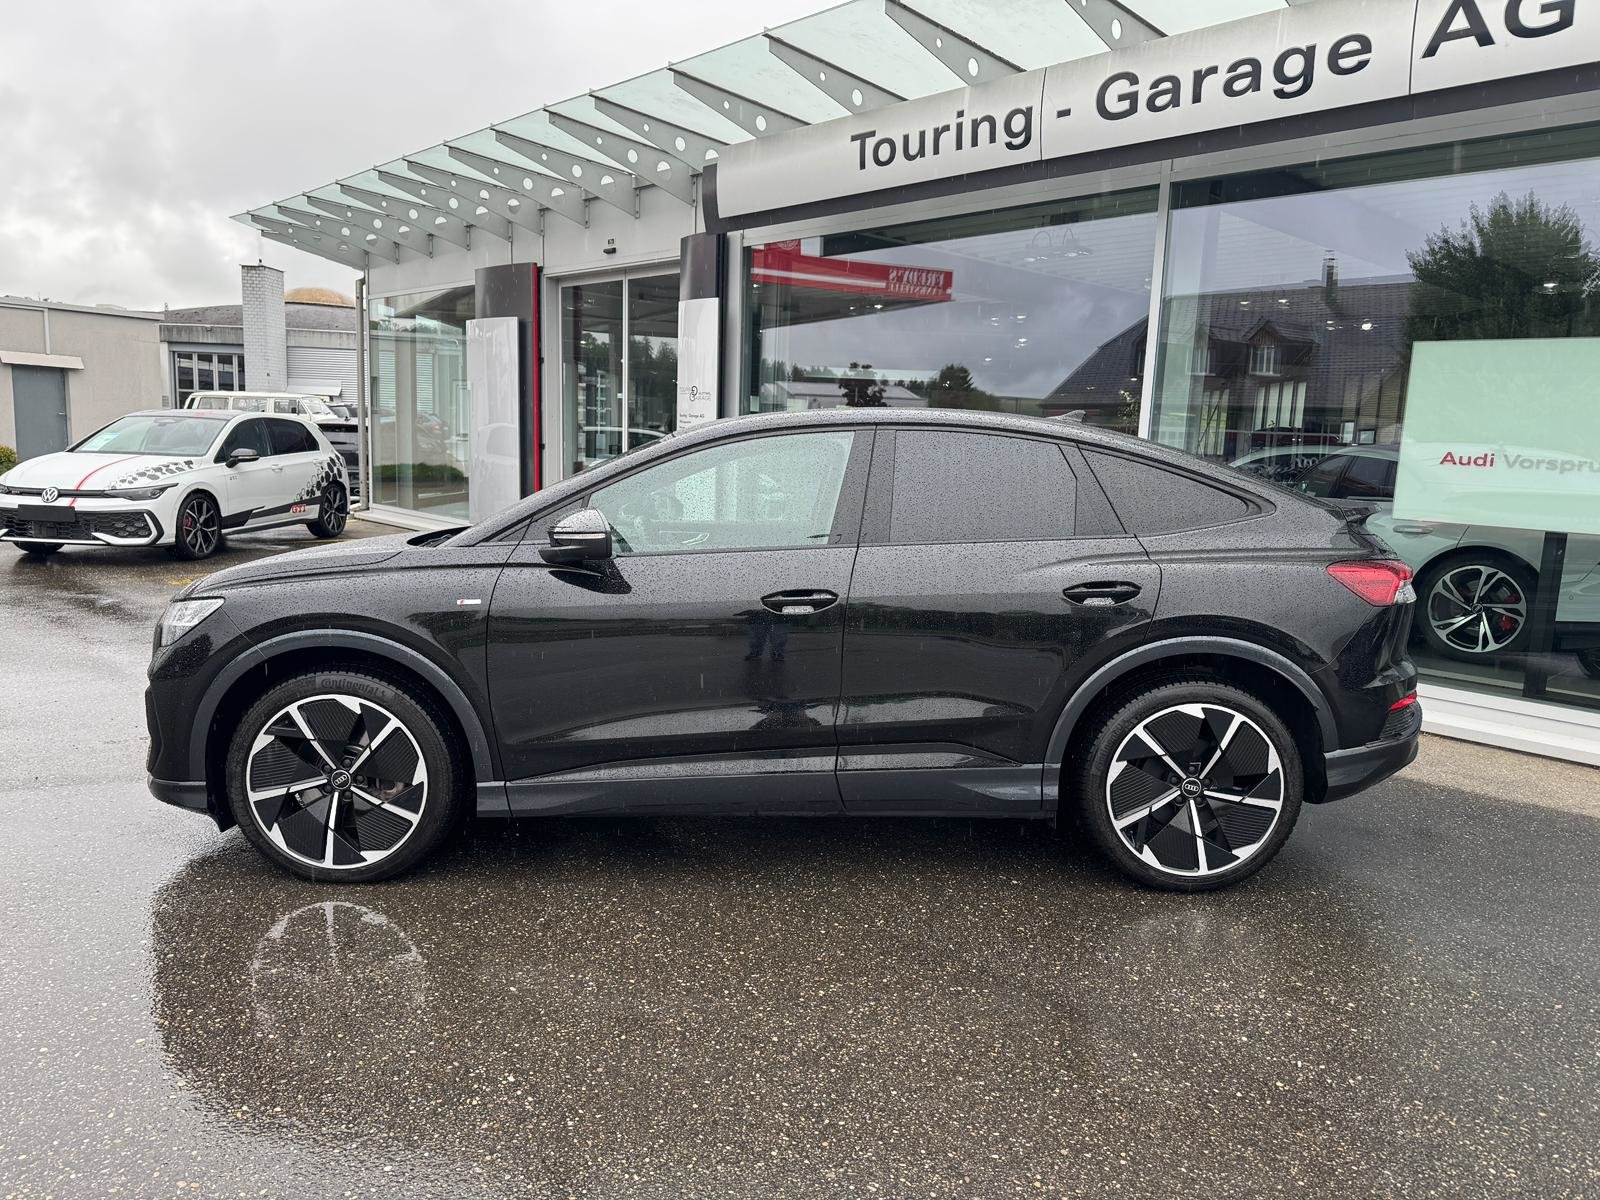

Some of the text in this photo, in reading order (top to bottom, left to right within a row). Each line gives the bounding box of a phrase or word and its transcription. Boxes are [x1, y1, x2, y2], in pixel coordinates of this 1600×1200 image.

[850, 0, 1575, 170] Touring - Garage AG
[1439, 451, 1495, 467] Audi
